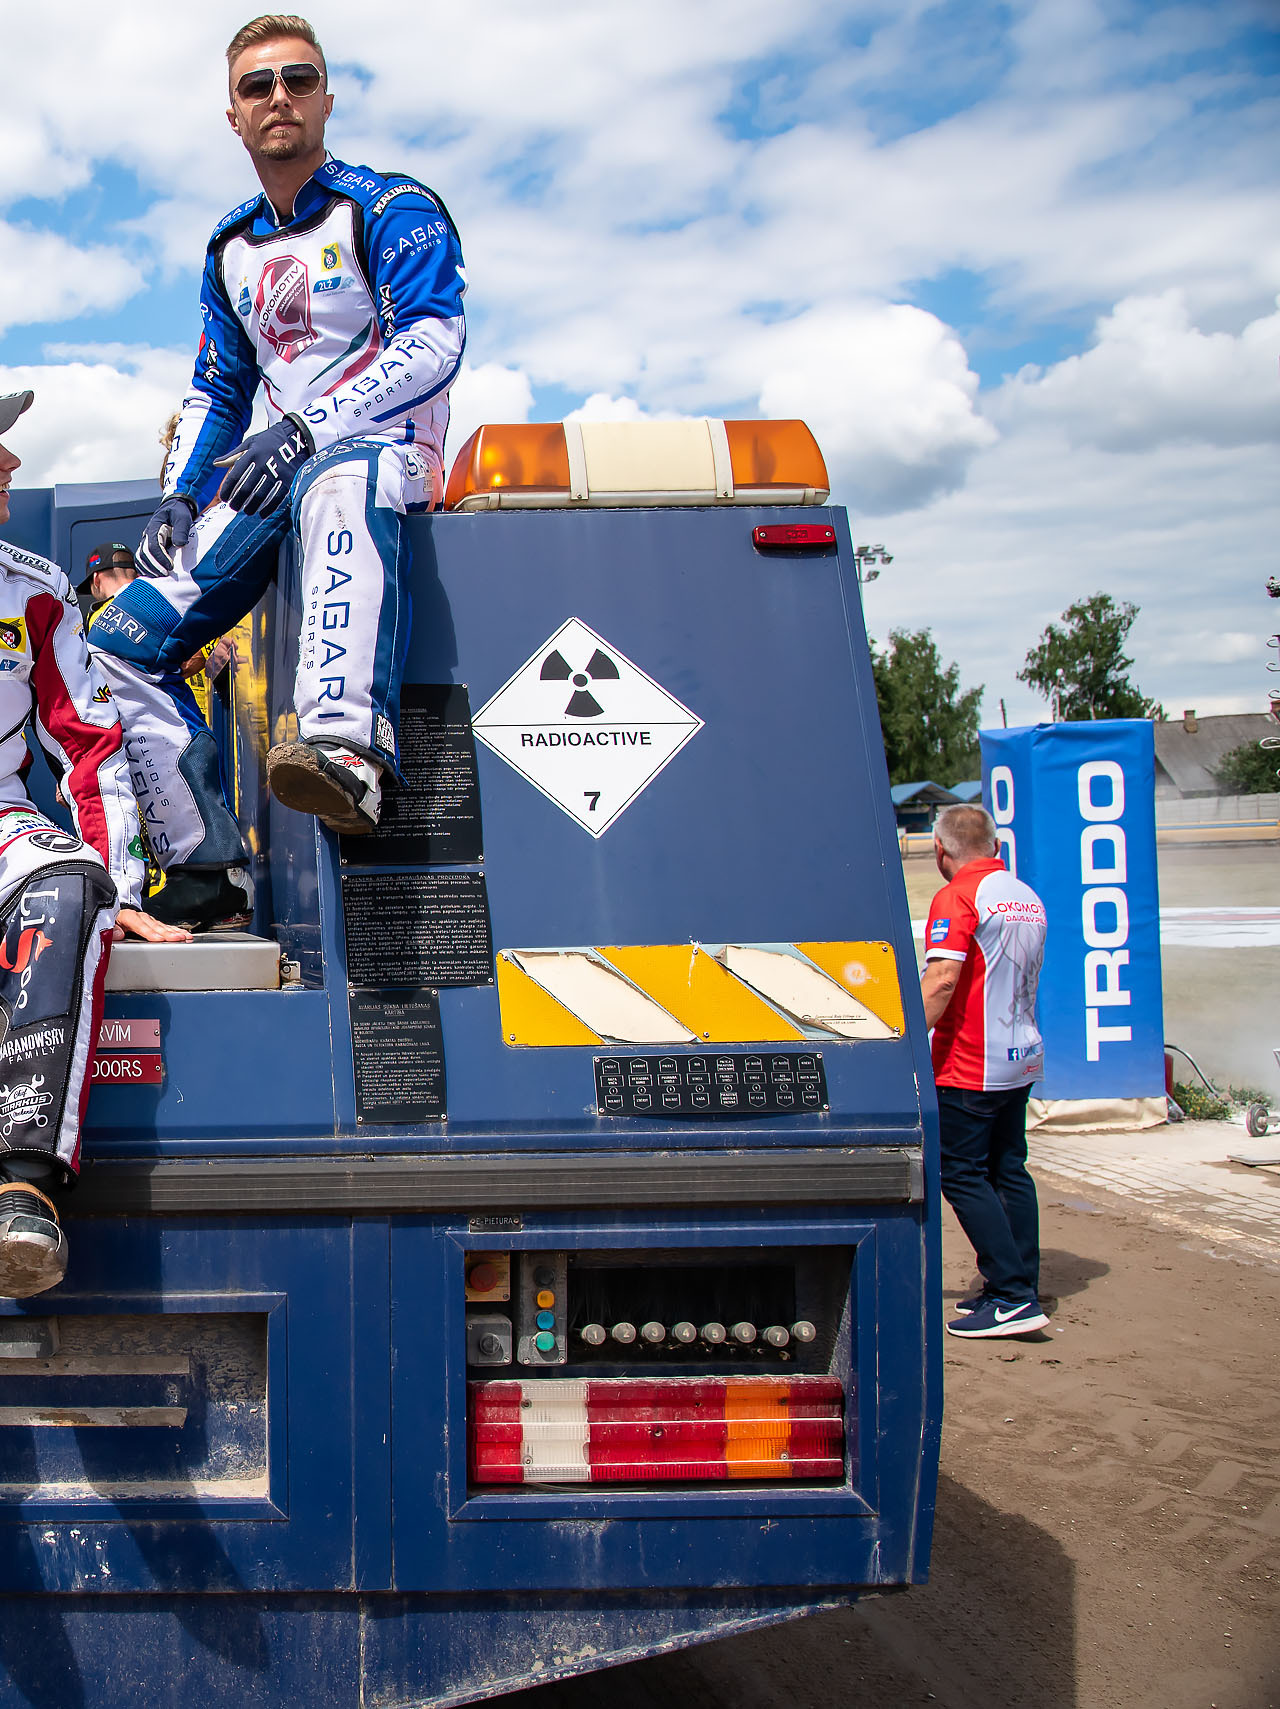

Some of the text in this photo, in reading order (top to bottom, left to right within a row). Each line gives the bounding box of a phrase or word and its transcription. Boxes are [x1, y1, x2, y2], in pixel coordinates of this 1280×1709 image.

[325, 163, 381, 196] SAGARI
[260, 265, 299, 328] LOKOMOTIV
[303, 338, 425, 424] SAGAR
[353, 372, 413, 418] SPORTS
[267, 431, 307, 479] FOX
[101, 605, 147, 643] GARI
[306, 585, 319, 670] SPORTS
[317, 529, 353, 719] SAGARI
[520, 731, 652, 747] RADIOACTIVE
[122, 728, 170, 856] SAGA
[138, 735, 170, 808] SPORTS
[583, 791, 601, 812] 7
[987, 901, 1046, 916] LOKOMOT
[1077, 760, 1132, 1063] TRODO
[99, 1021, 132, 1042] RVĪM
[8, 1046, 56, 1065] FAMILY
[0, 1095, 48, 1114] MARKUS
